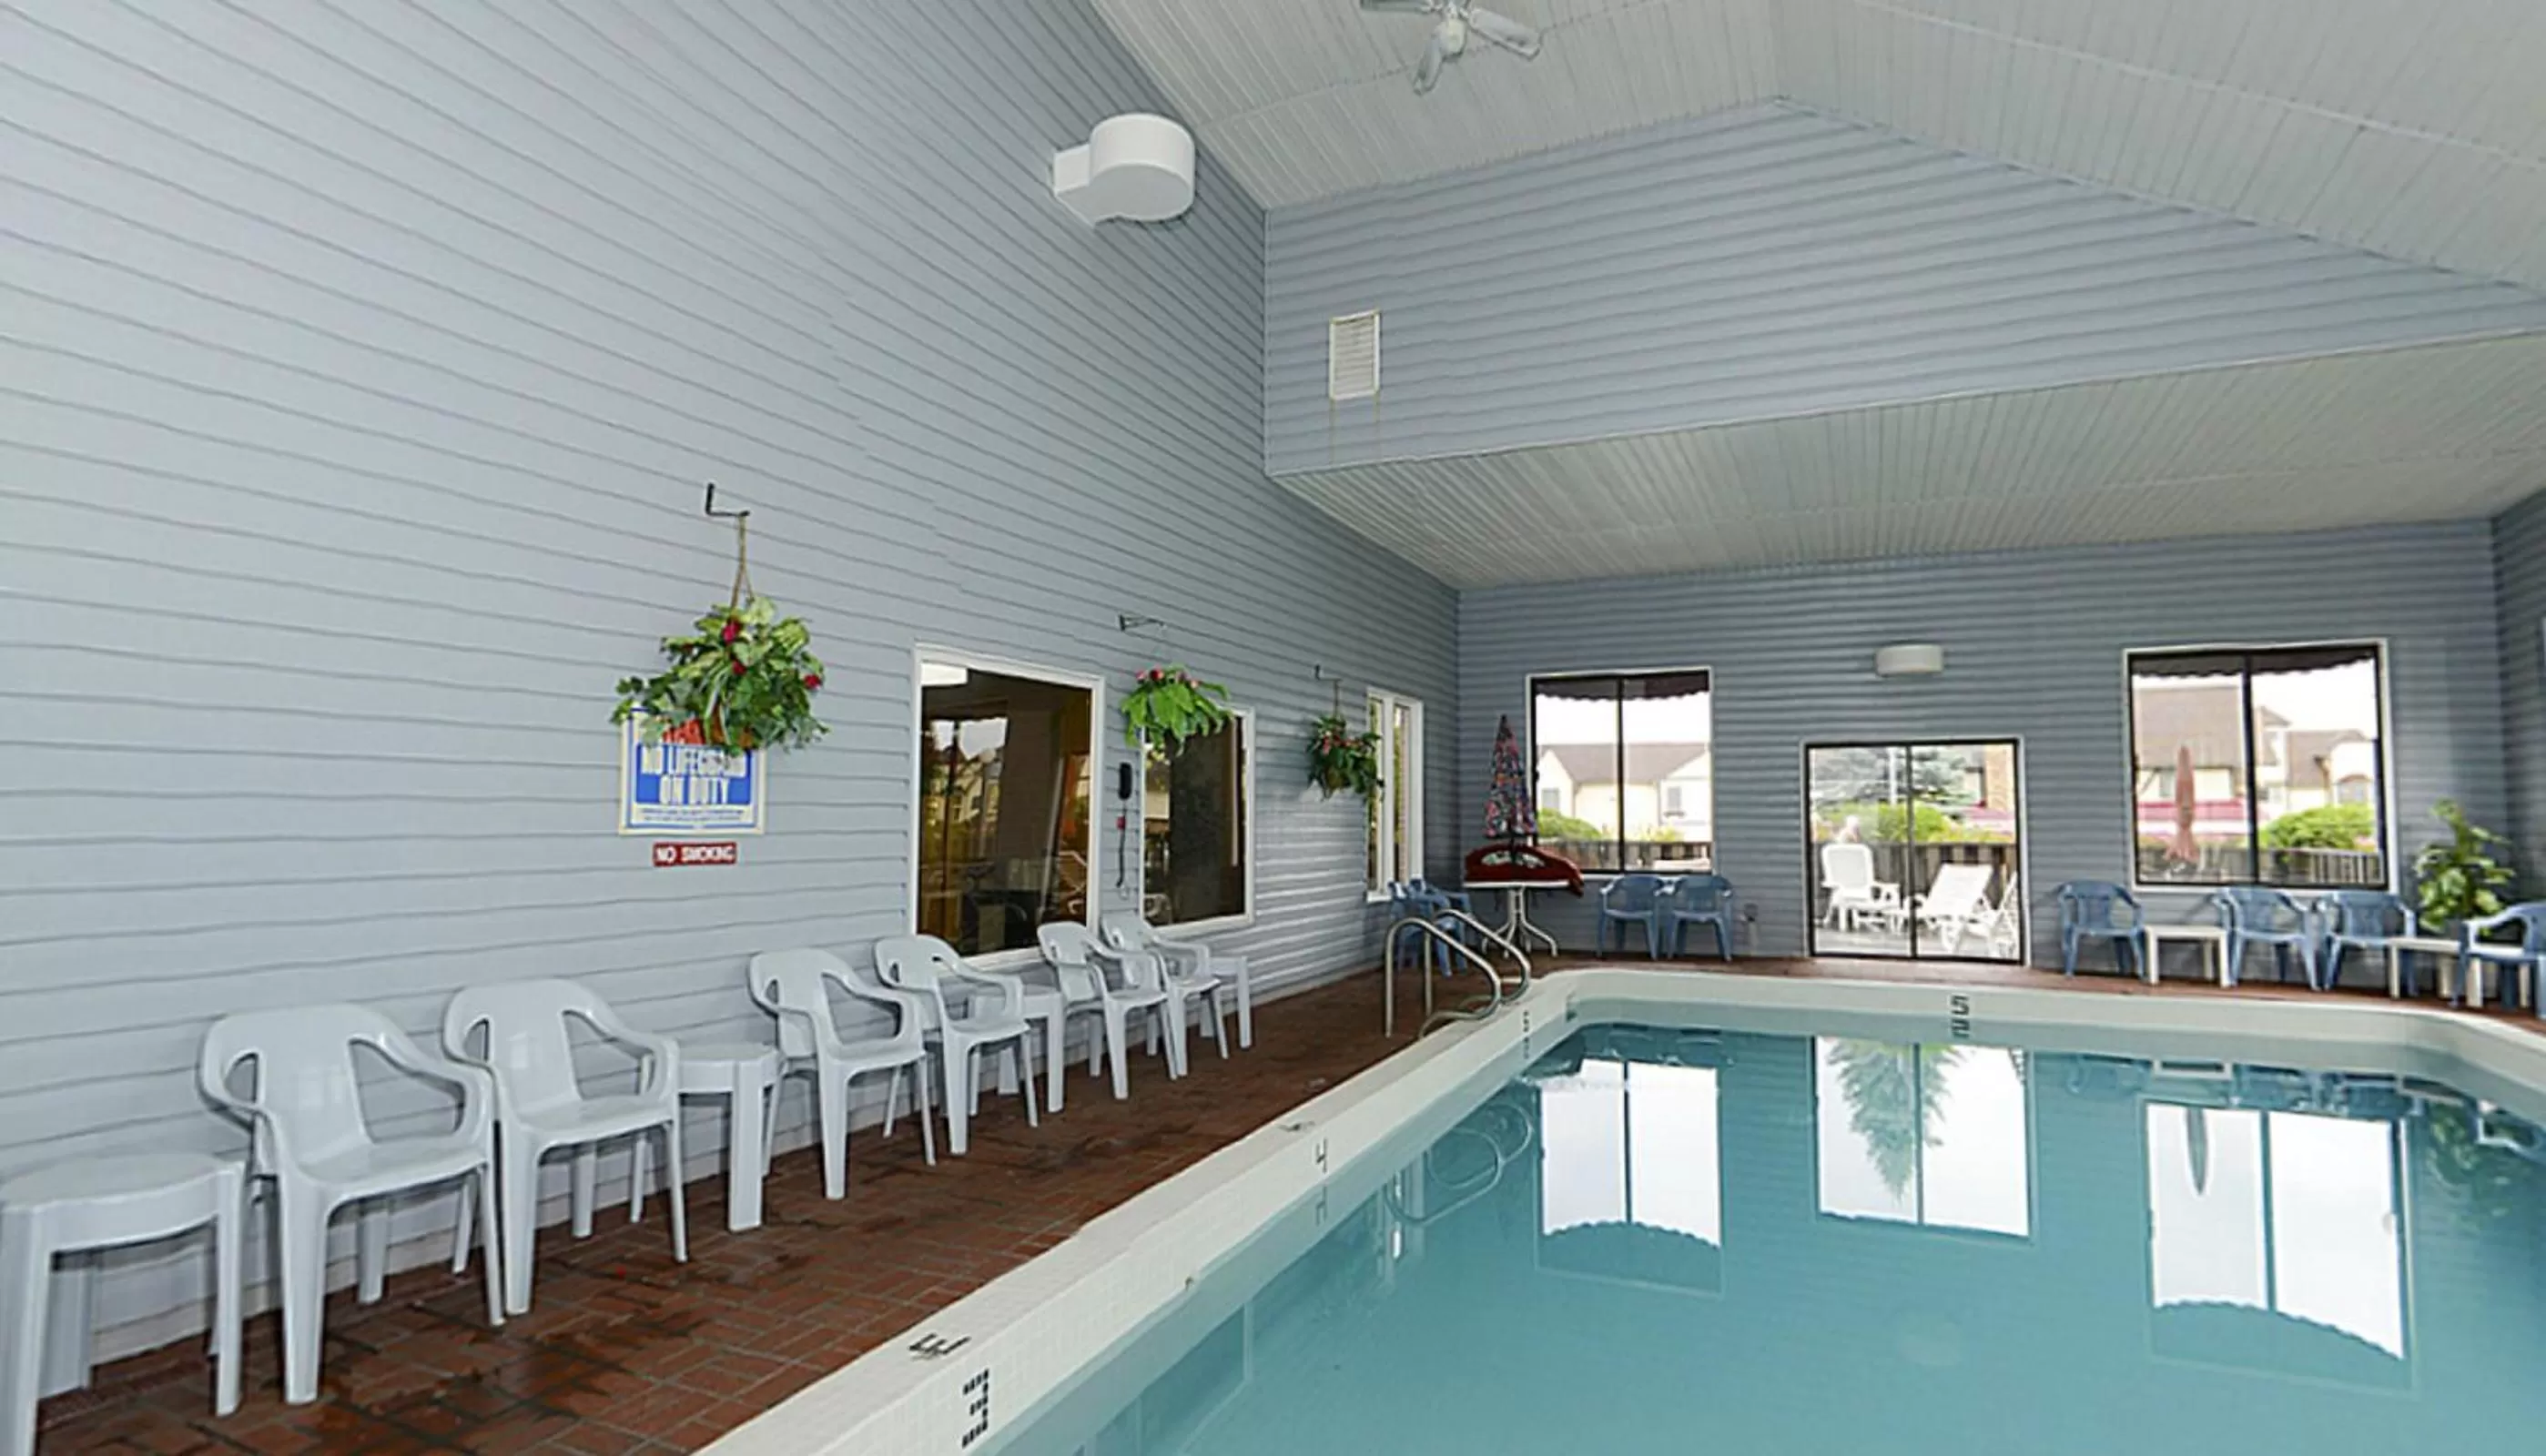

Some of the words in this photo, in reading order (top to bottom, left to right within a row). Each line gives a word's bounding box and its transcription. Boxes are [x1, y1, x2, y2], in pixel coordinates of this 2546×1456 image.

[641, 746, 664, 774] NO
[659, 776, 685, 804] ON
[688, 777, 730, 804] DUTY
[656, 845, 677, 863] NO
[681, 845, 735, 862] SMOKING
[1951, 995, 1970, 1016] 5
[1315, 1138, 1327, 1173] 4
[962, 1369, 989, 1449] 3
